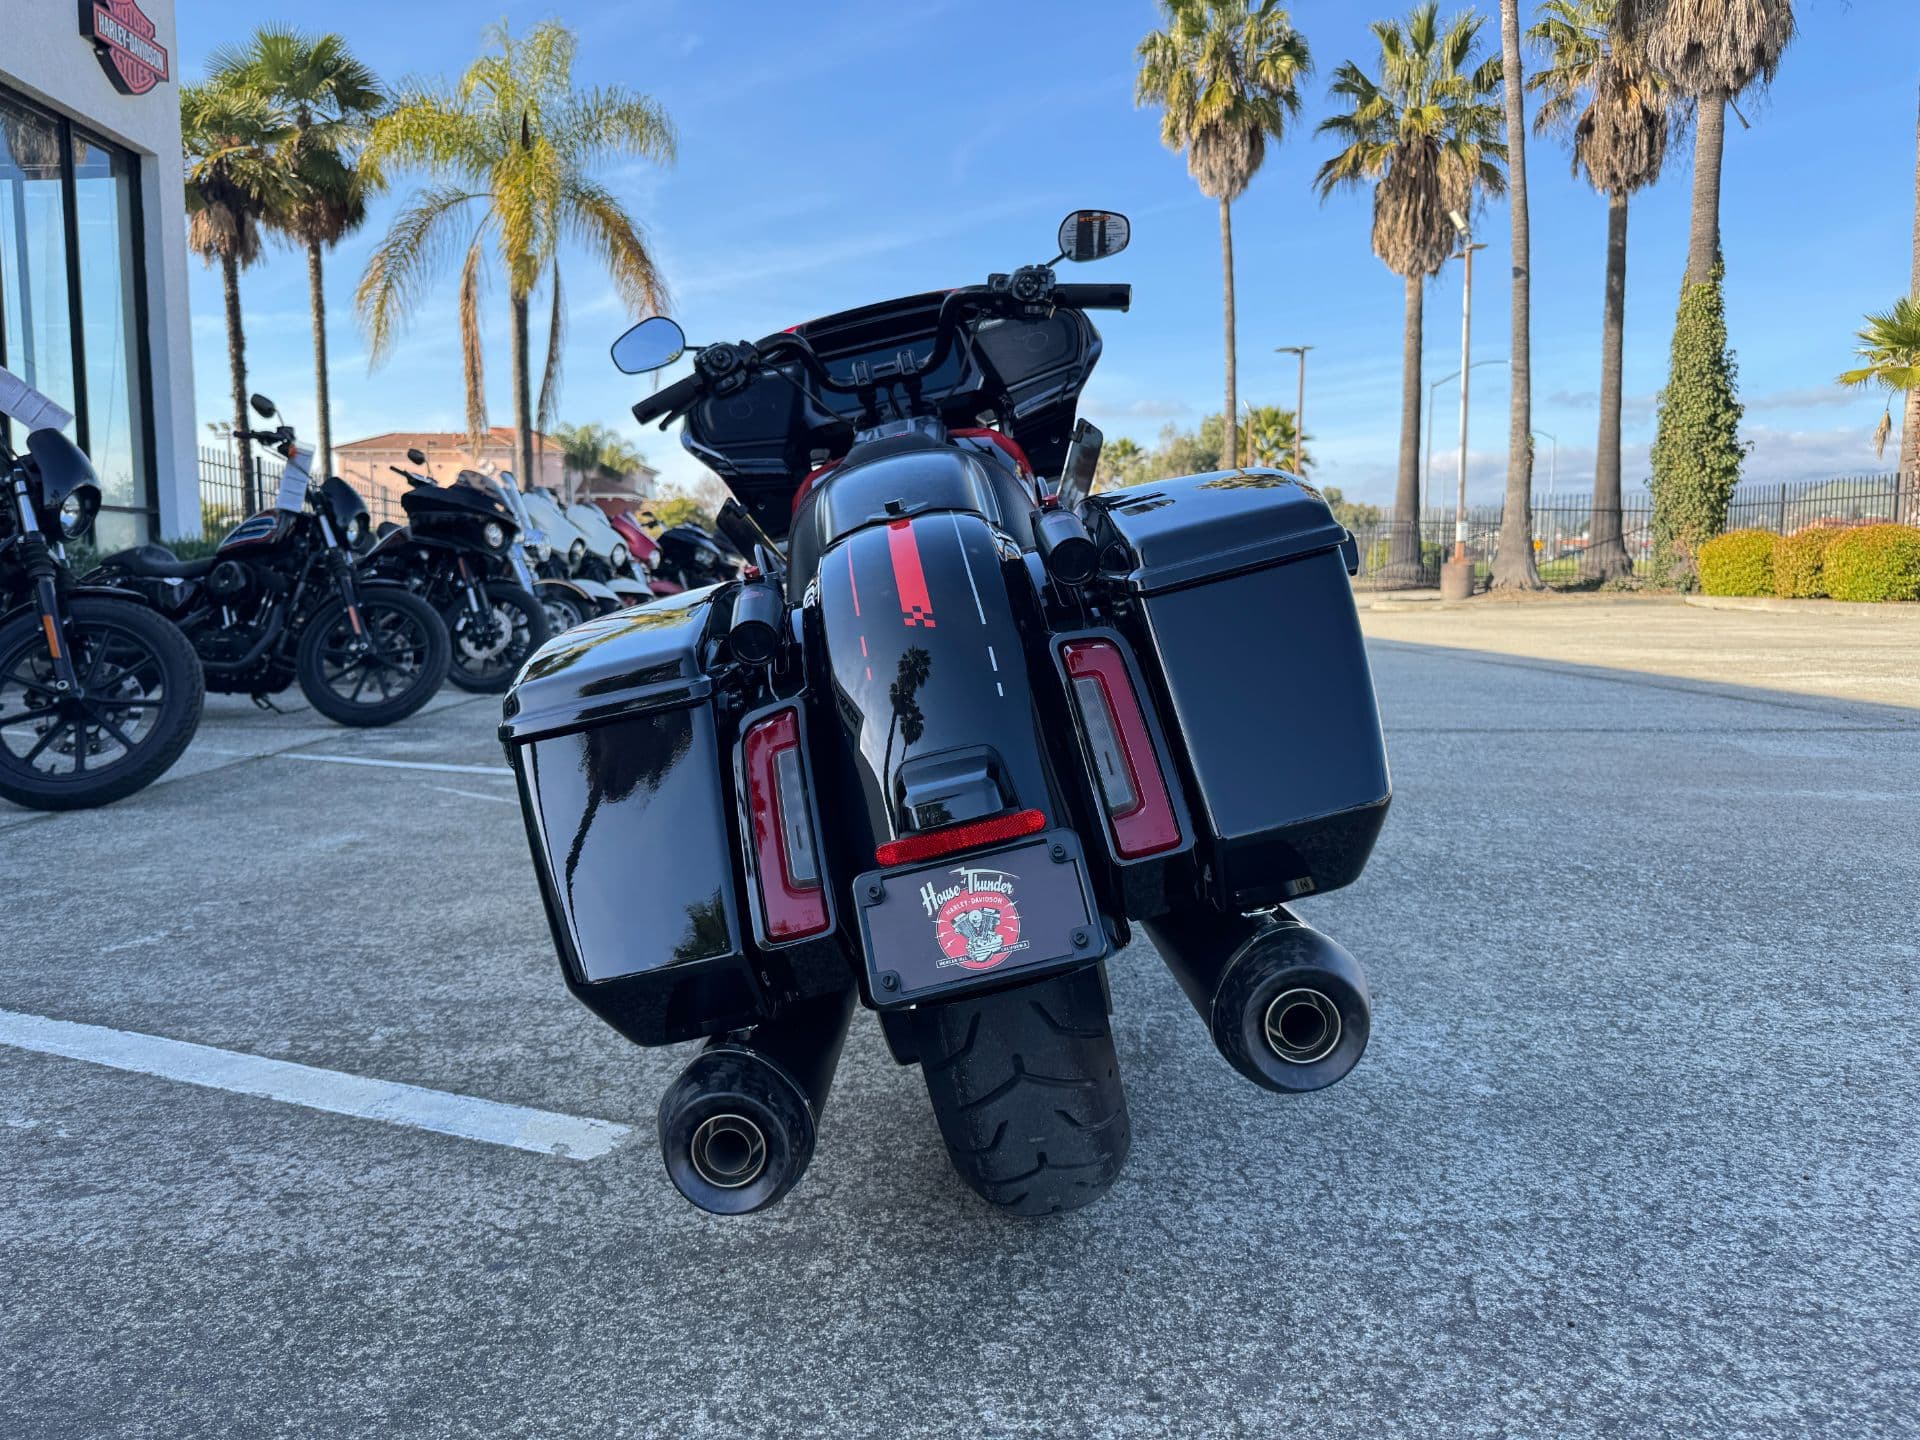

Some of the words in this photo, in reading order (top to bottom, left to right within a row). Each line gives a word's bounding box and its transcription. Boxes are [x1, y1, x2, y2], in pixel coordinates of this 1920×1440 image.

[98, 12, 164, 72] HARLEY-DAVIDSON
[117, 52, 150, 83] CYCLES
[919, 881, 960, 916] House
[951, 867, 1018, 895] Thunder
[945, 896, 1003, 916] HARLEY-DAVIDSON
